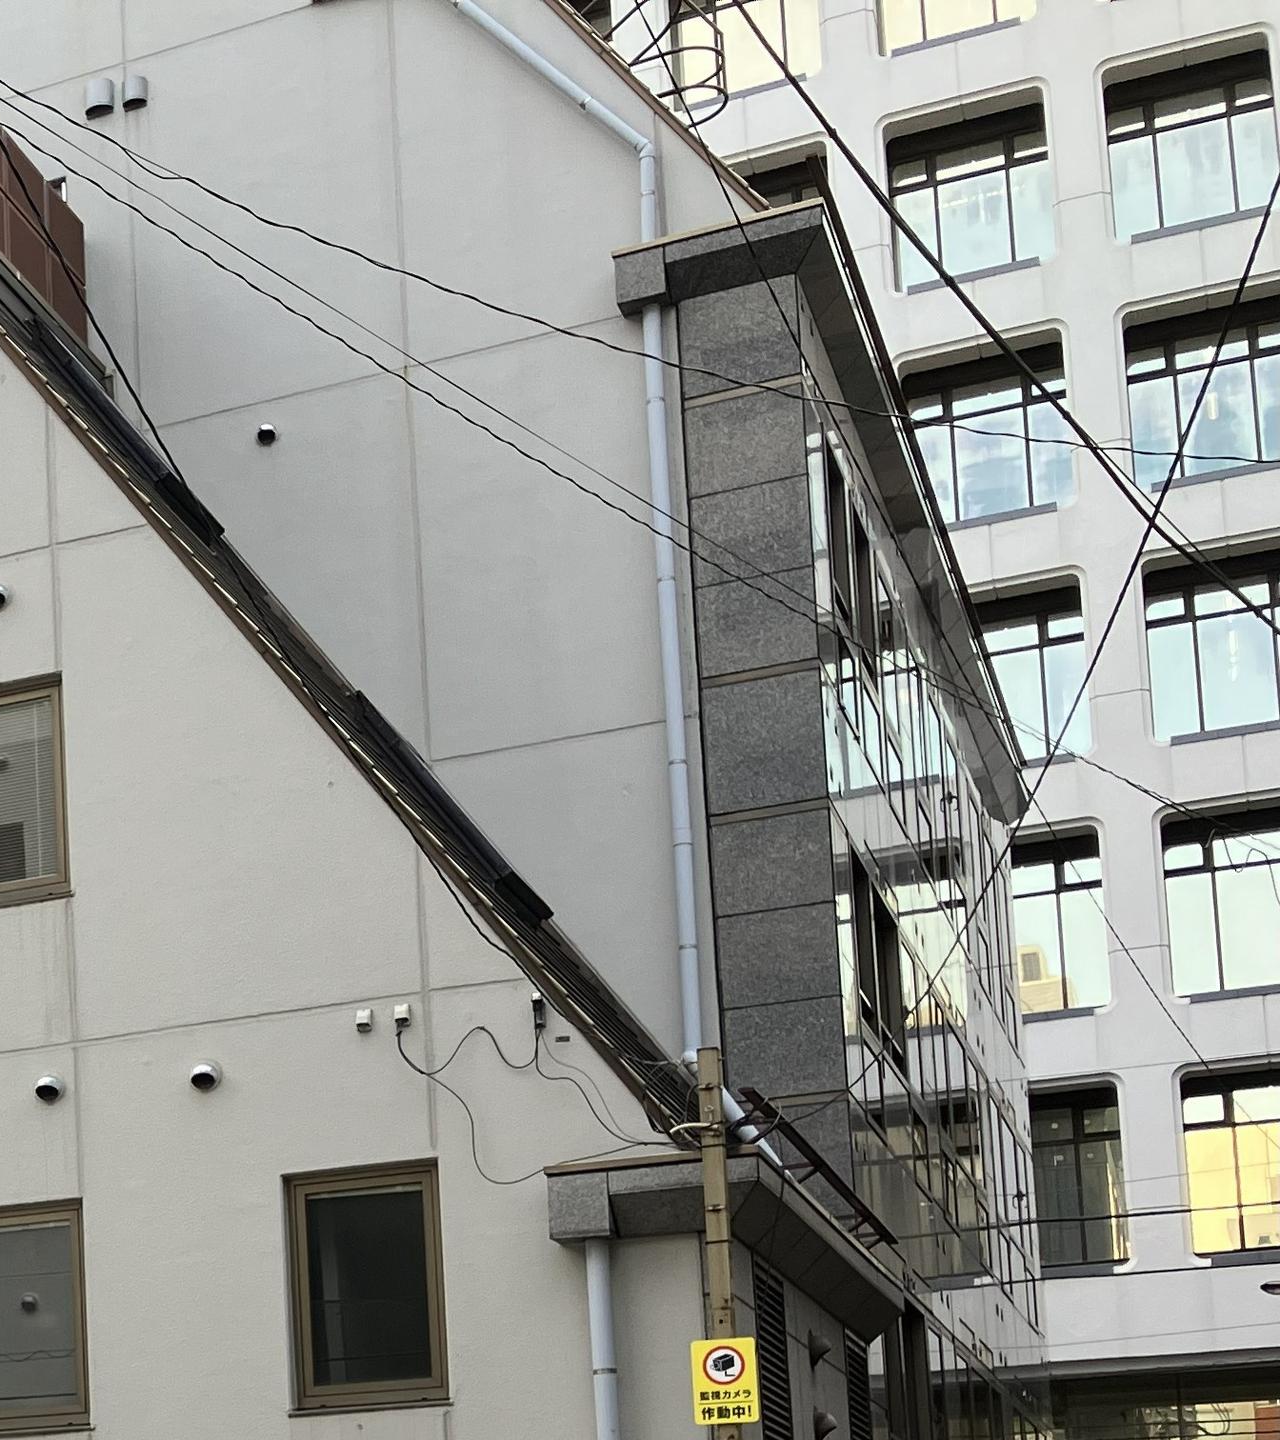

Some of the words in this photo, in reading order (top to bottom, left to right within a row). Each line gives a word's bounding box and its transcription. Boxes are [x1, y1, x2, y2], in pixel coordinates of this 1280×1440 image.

[700, 1390, 751, 1401] 監視カメラ
